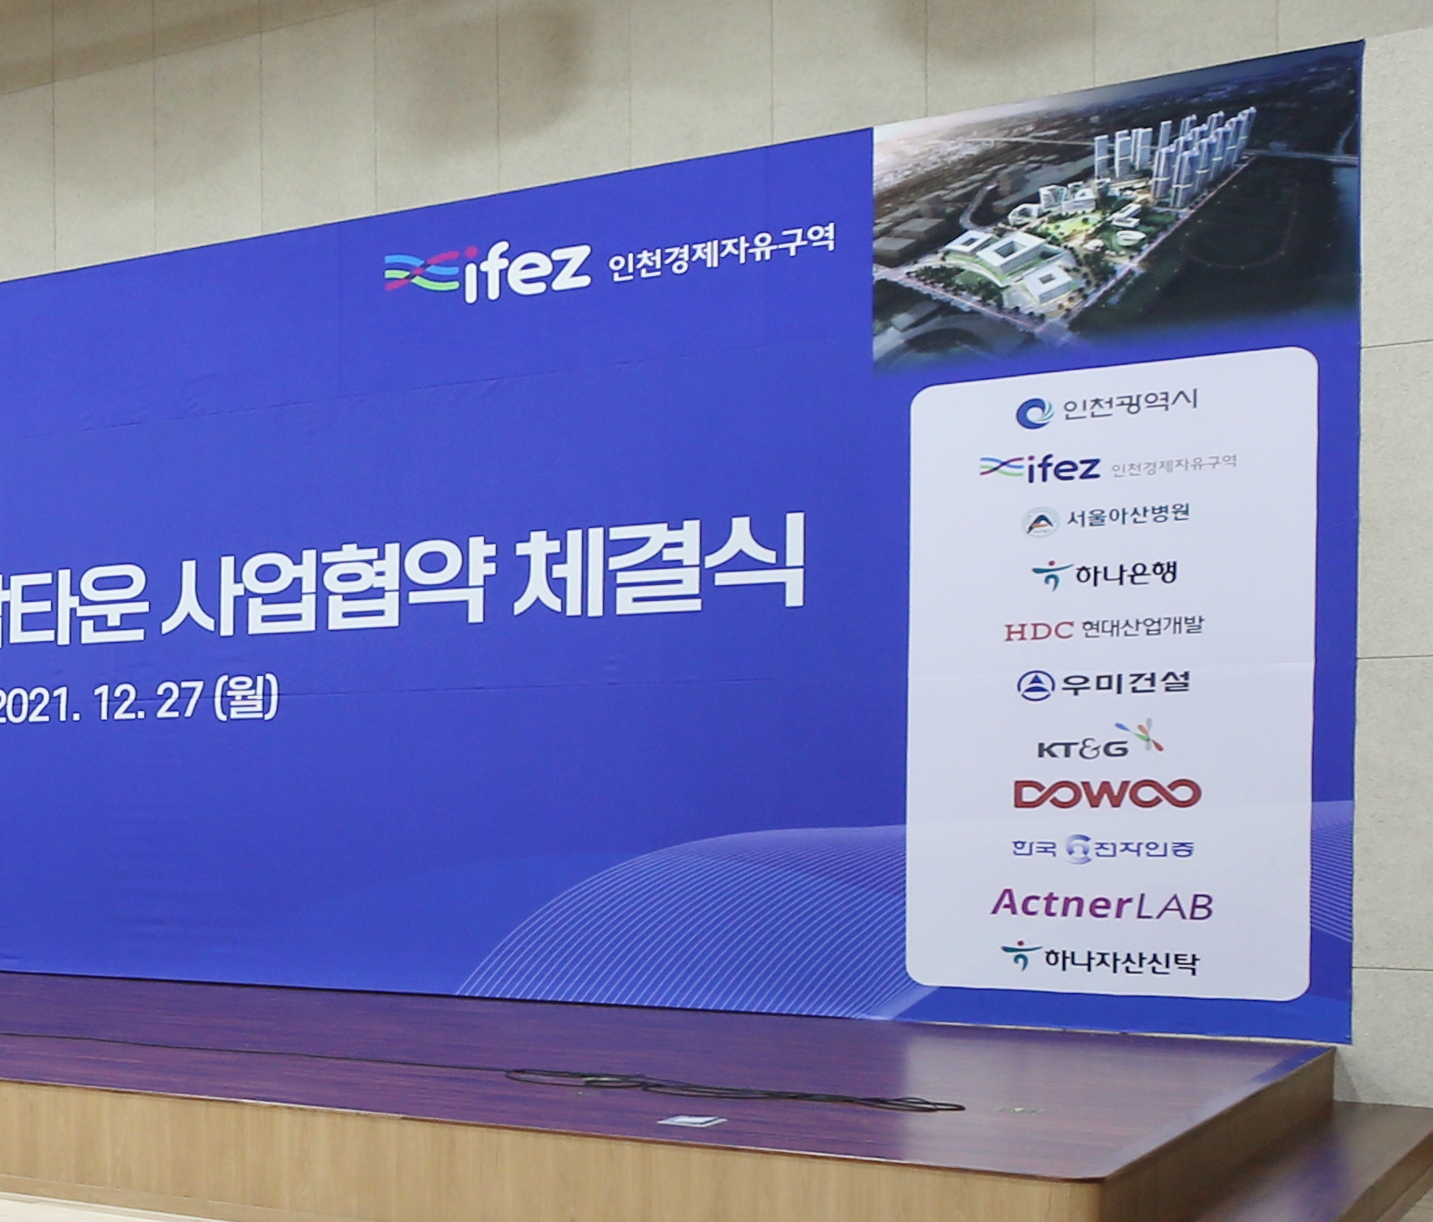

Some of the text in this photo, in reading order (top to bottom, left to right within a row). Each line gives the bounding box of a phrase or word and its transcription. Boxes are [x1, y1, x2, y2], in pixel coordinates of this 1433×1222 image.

[609, 223, 834, 281] 인천경제자유구역
[466, 242, 591, 303] ifez
[1064, 388, 1197, 420] 인천광역시
[1028, 454, 1101, 483] ifez
[1112, 455, 1236, 477] 인천경제자유구역
[1067, 503, 1189, 527] 서울아산병원
[162, 537, 496, 636] 사업협약
[514, 513, 804, 616] 체결식
[1076, 561, 1177, 587] 하나은행
[1005, 616, 1205, 641] HDC 현대산업개발
[95, 684, 144, 719] 12.
[157, 681, 203, 717] 27
[215, 674, 277, 721] (월)
[1062, 671, 1190, 696] 우미건설
[1038, 738, 1129, 759] KT&G
[1014, 779, 1202, 809] DOWOO
[1012, 841, 1056, 857] 한국
[990, 889, 1213, 920] ActnerLAB
[1045, 949, 1200, 976] 하나자산신탁
